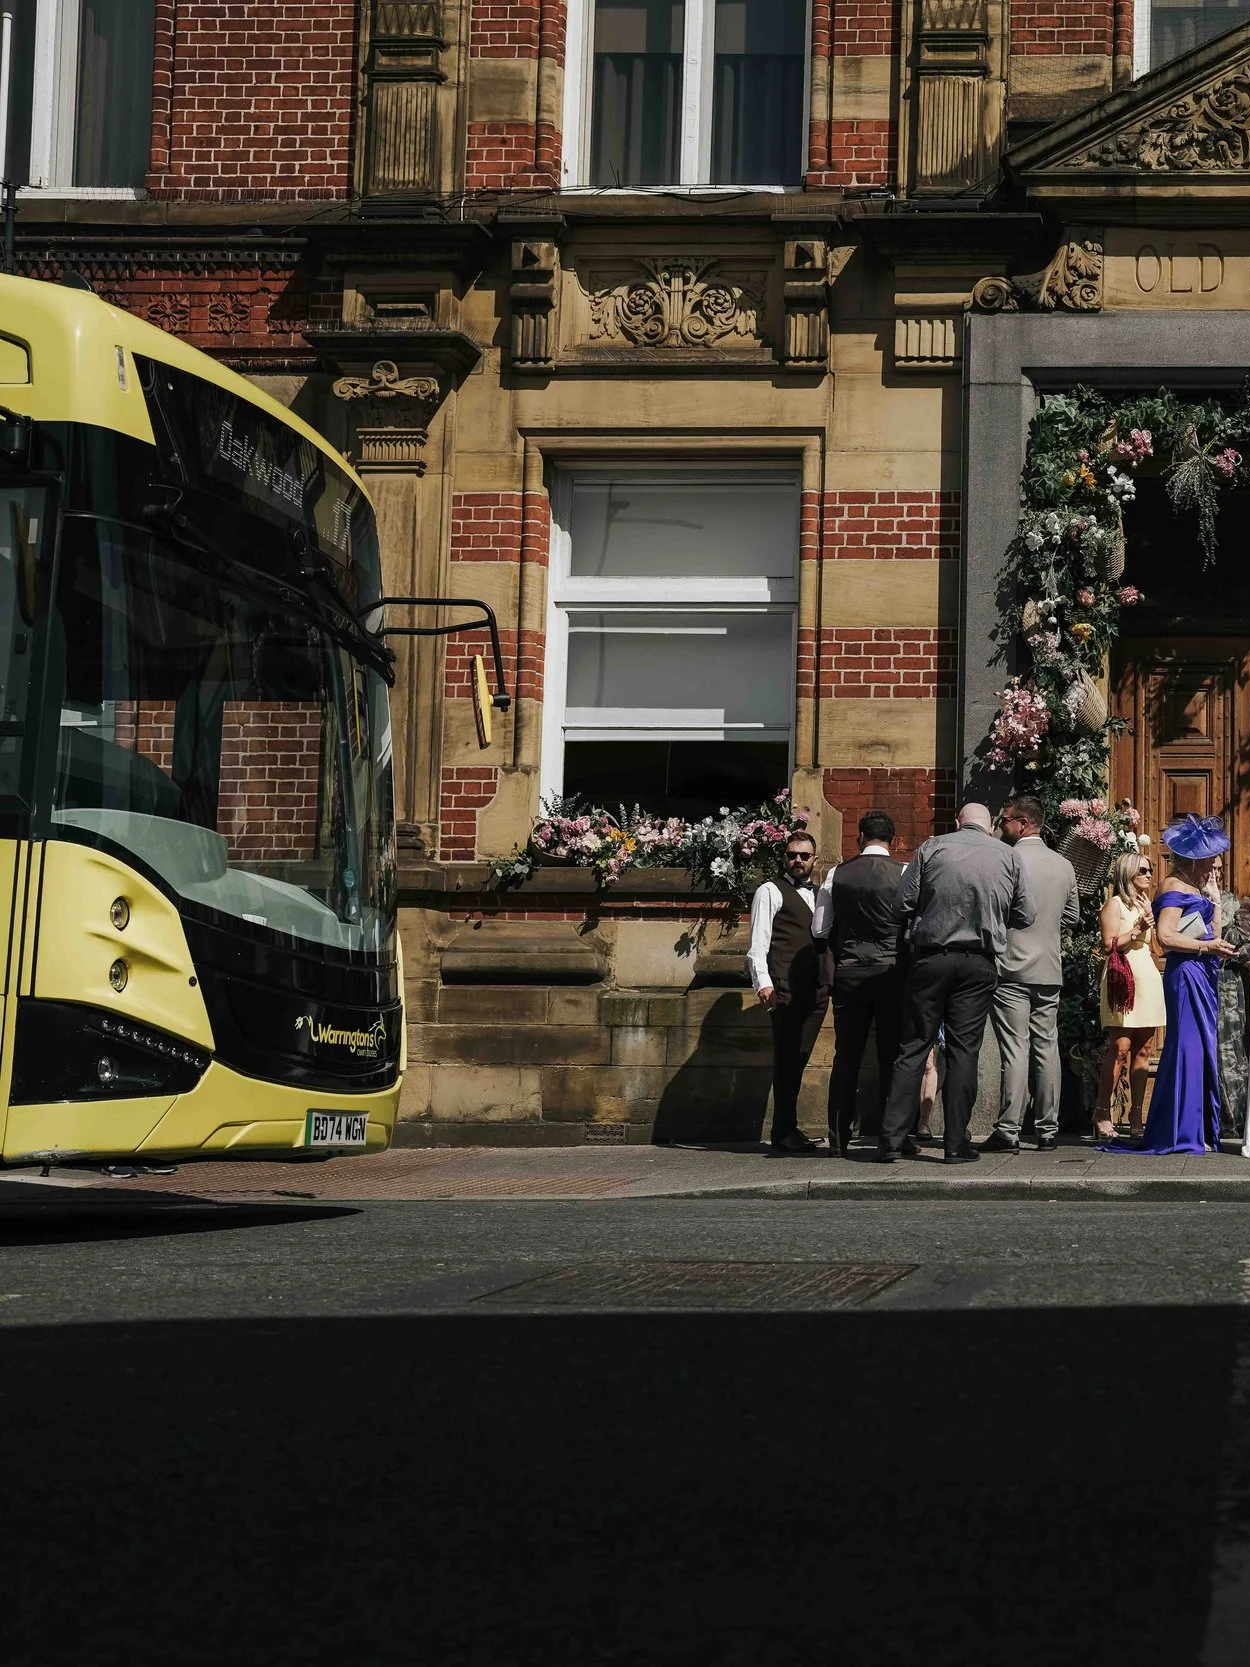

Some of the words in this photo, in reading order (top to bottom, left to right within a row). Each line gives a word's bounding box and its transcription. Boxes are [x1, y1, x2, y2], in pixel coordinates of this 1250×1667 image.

[1135, 244, 1225, 294] OLD
[219, 420, 305, 508] Oakwood
[313, 1116, 342, 1140] BD74
[345, 1117, 366, 1140] WGN
